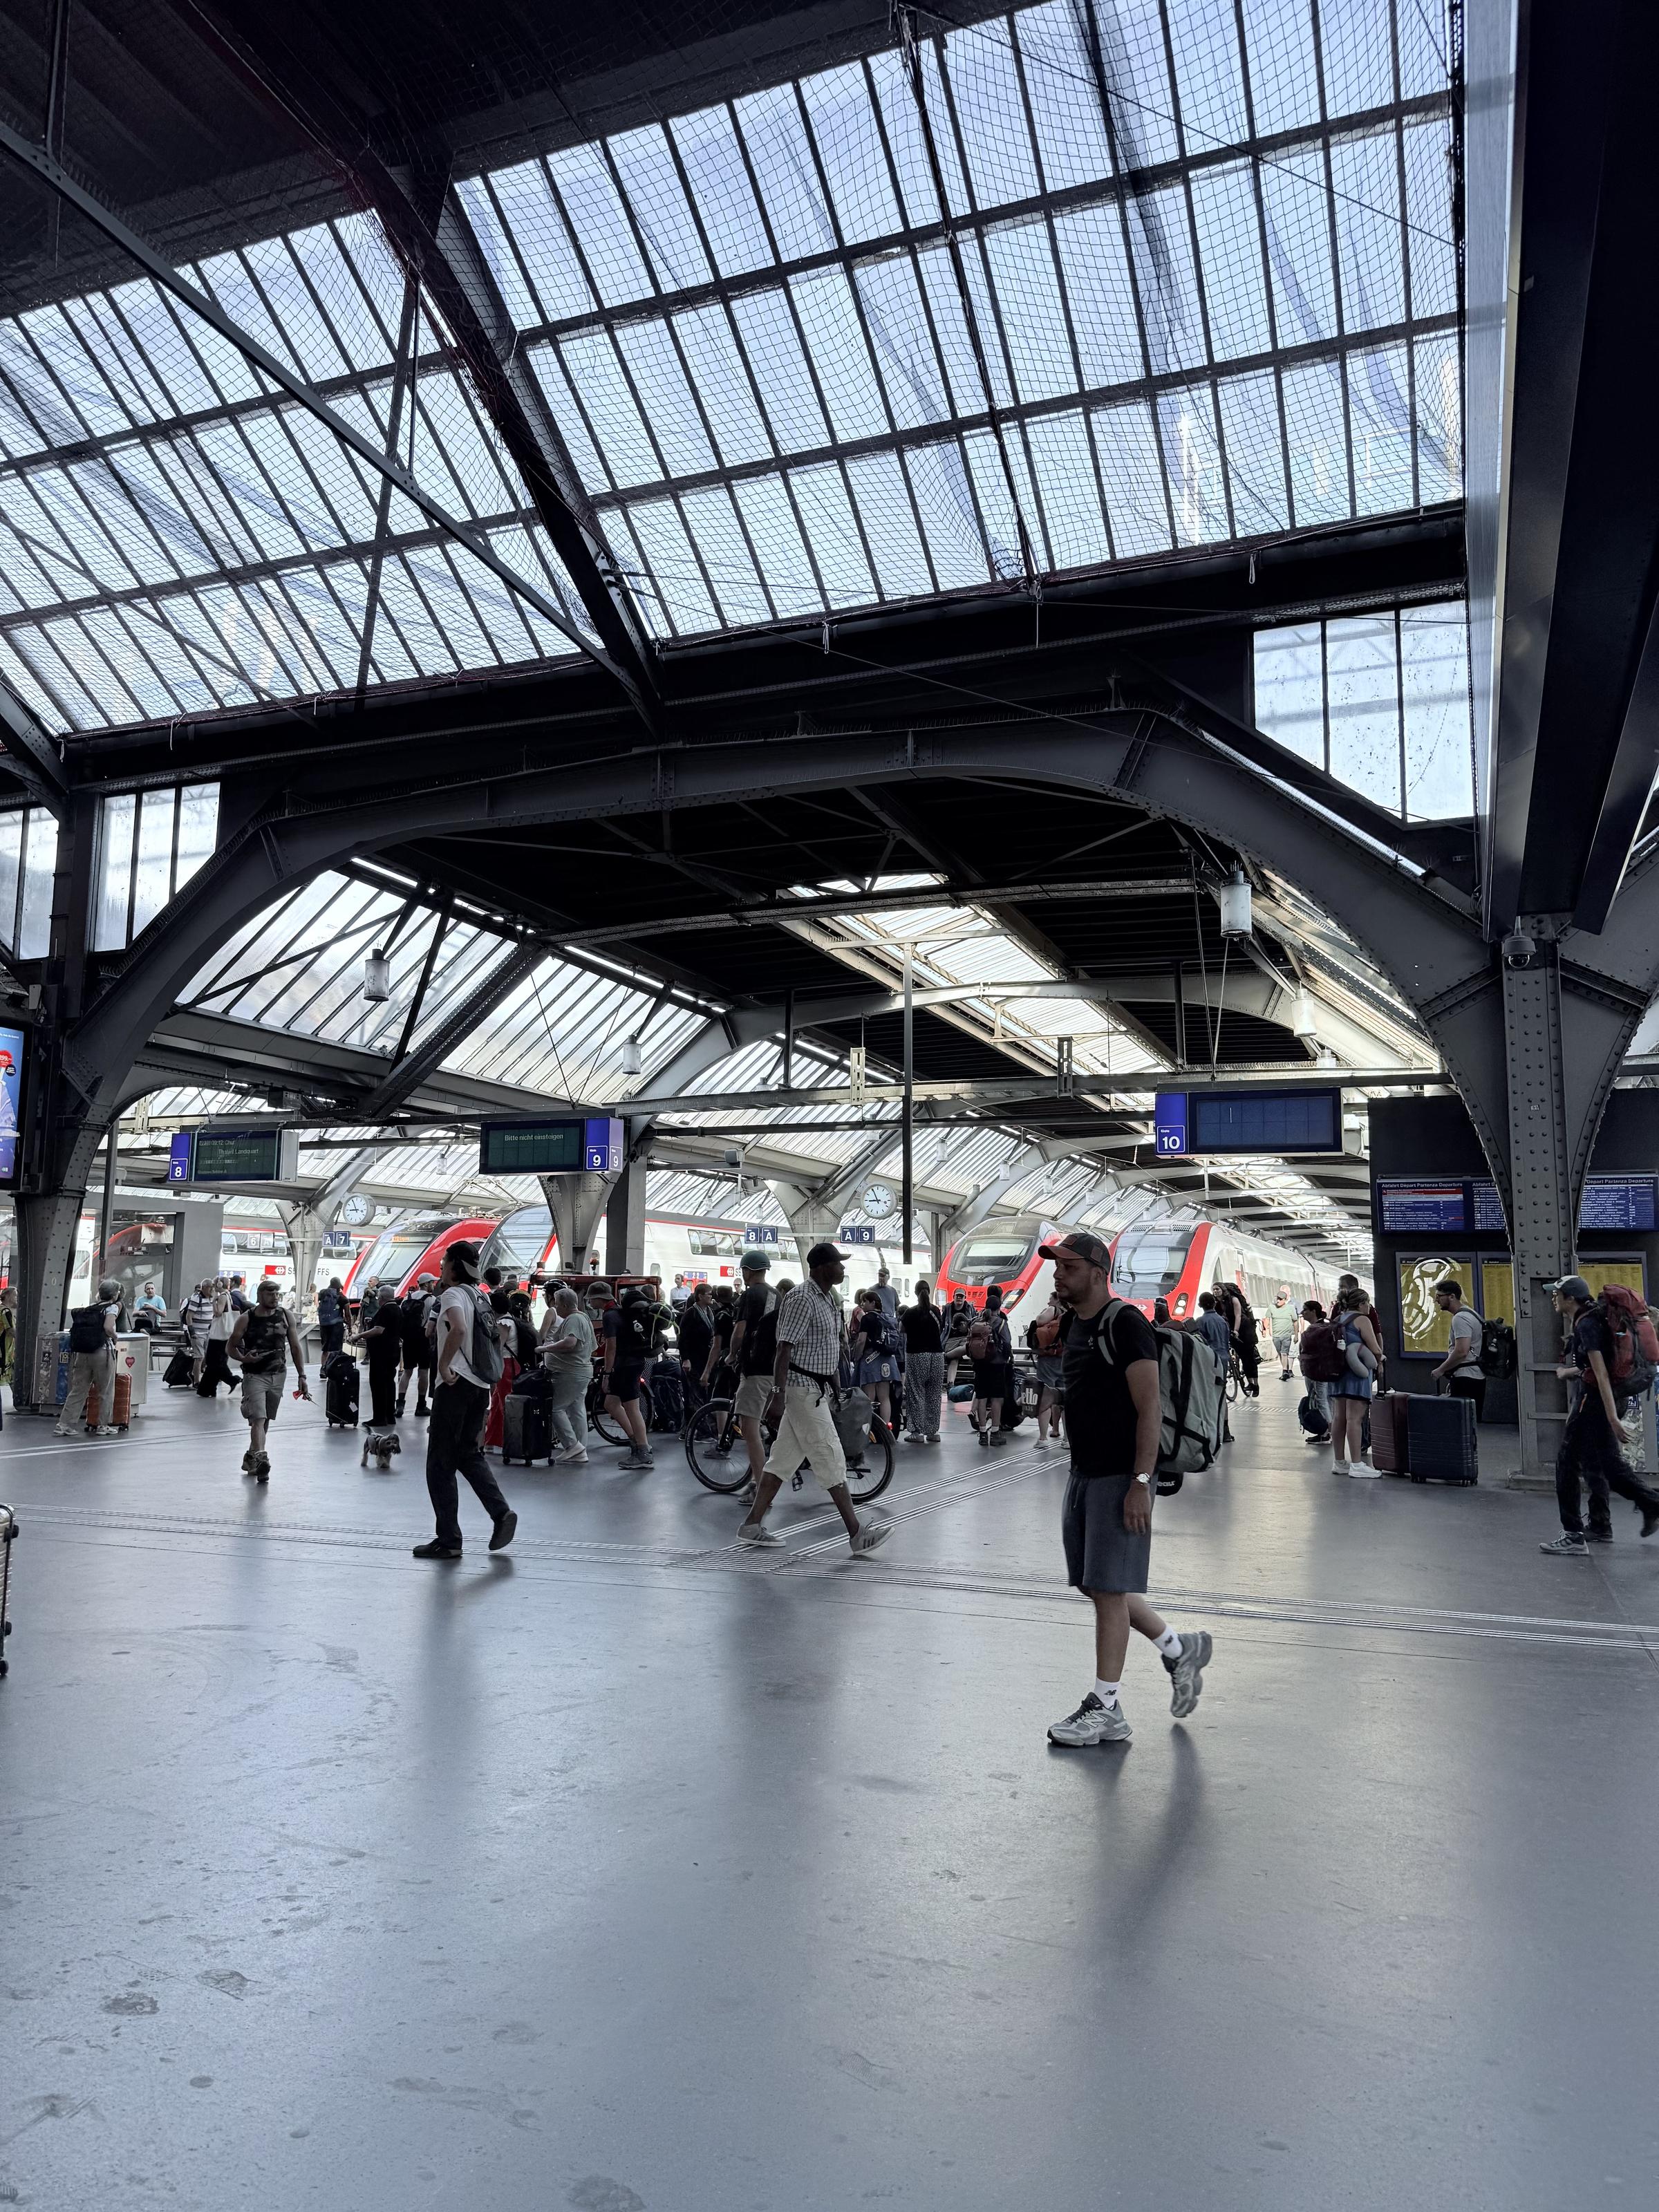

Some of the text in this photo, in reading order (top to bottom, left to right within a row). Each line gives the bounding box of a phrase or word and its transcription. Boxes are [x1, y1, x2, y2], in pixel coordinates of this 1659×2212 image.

[1162, 1136, 1180, 1150] 10
[592, 1154, 601, 1166] 9
[613, 1155, 619, 1167] 9
[175, 1166, 182, 1177] 8
[339, 1236, 346, 1244] 7
[749, 1231, 756, 1240] 8
[765, 1231, 773, 1240] A
[845, 1231, 852, 1240] A
[863, 1231, 870, 1240] 9
[250, 1237, 256, 1245] 6
